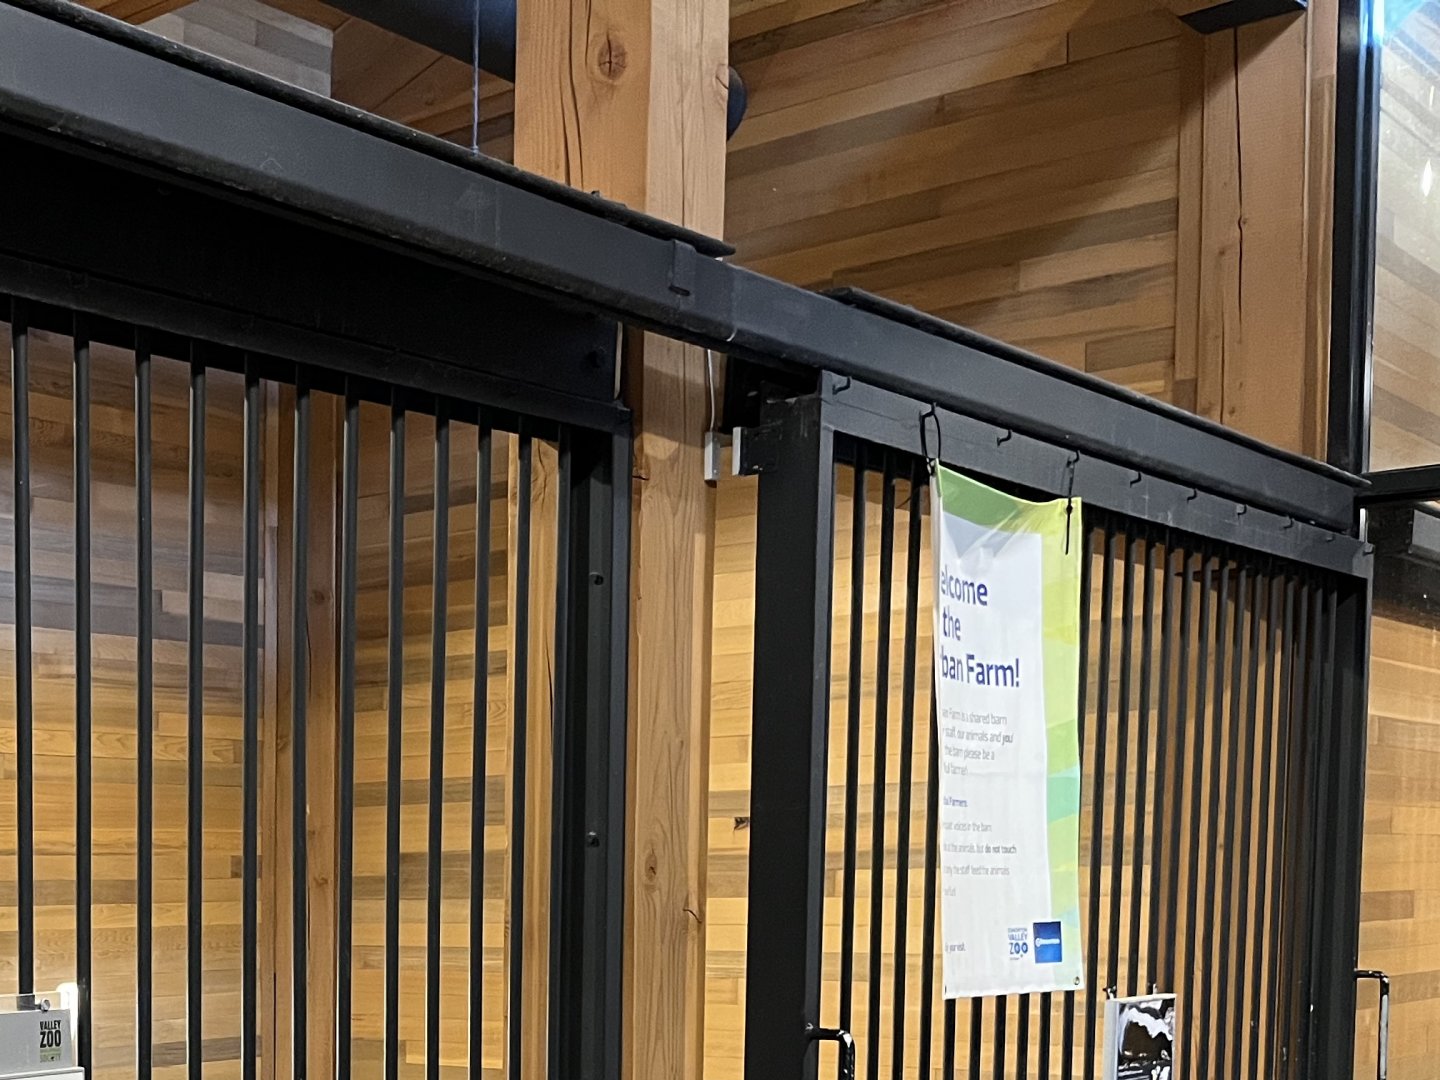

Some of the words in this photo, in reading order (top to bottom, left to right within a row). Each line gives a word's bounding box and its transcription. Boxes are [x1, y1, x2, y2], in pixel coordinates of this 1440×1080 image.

[940, 564, 988, 606] elcome
[942, 605, 961, 641] the
[940, 645, 963, 682] ban
[966, 653, 1019, 688] Farm!
[1008, 932, 1028, 941] VALLEY
[1009, 942, 1028, 955] ZOO
[40, 1019, 61, 1030] VALLEY
[40, 1030, 61, 1048] ZOO
